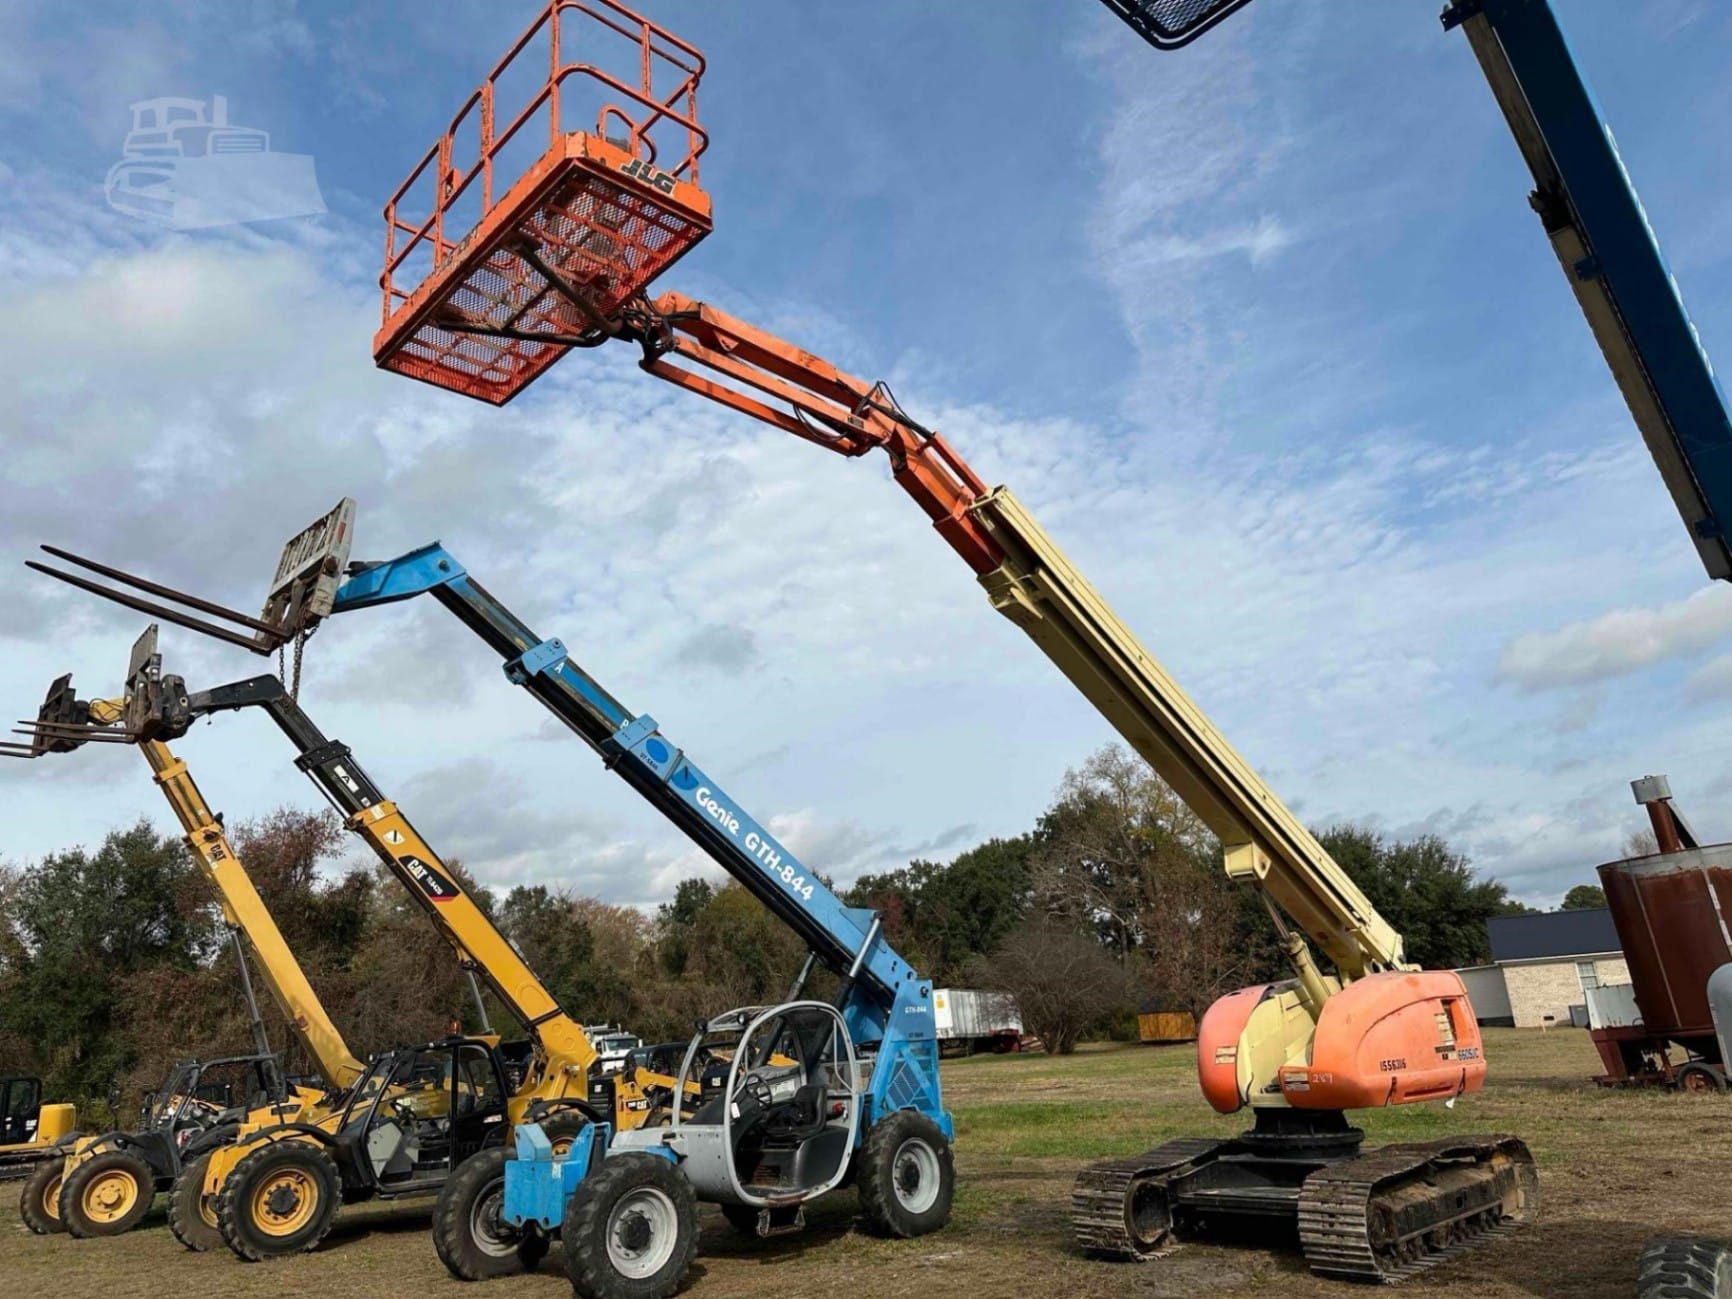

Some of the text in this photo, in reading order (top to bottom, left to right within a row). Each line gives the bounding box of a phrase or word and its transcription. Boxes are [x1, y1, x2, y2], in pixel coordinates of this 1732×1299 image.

[620, 158, 677, 196] JLG
[554, 661, 565, 675] A
[210, 843, 227, 861] CAT
[695, 786, 815, 901] Genie GTH-844
[407, 859, 428, 880] CAT
